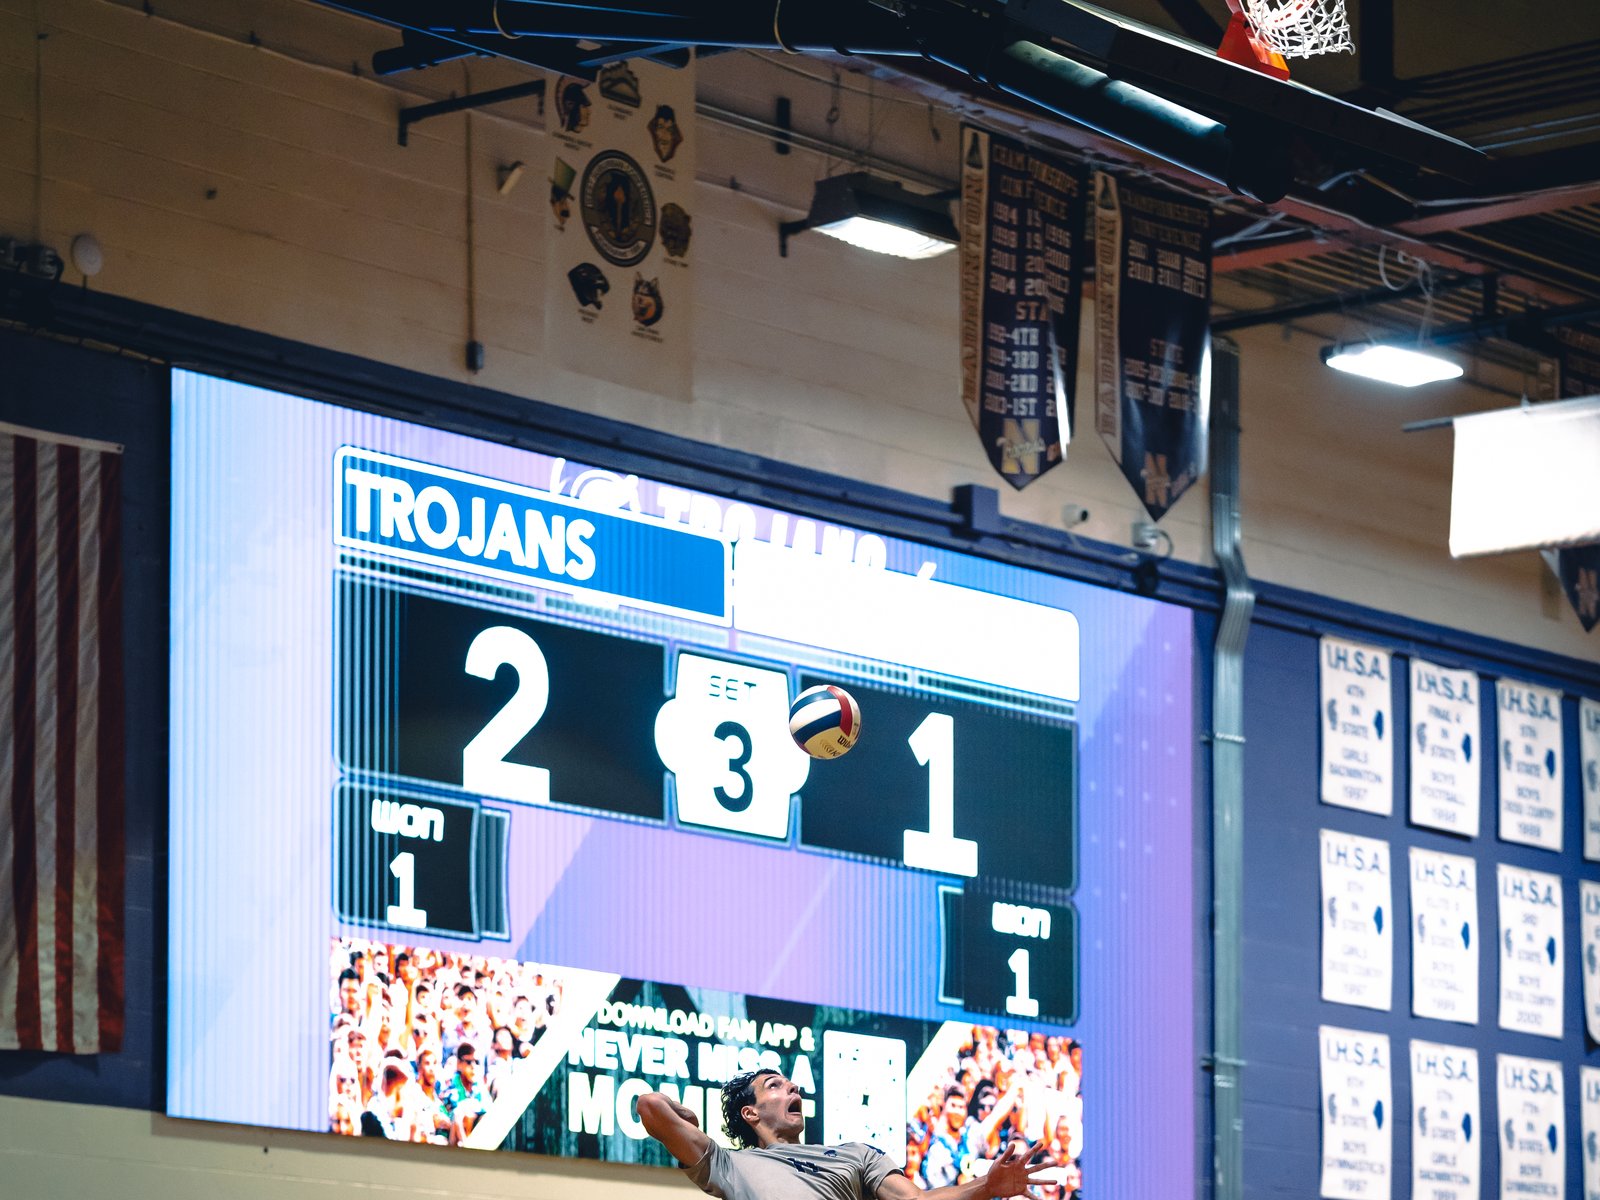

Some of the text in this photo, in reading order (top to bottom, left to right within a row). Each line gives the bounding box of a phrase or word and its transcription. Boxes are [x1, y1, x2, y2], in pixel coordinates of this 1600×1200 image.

[345, 468, 597, 581] TROJANS
[709, 675, 757, 702] SET
[1326, 645, 1386, 680] I.H.S.A.
[1417, 668, 1474, 704] I.H.S.A.
[463, 625, 550, 803] 2
[1500, 687, 1558, 722] I.H.S.A.
[713, 720, 754, 813] 3
[904, 711, 978, 877] 1
[387, 851, 427, 929] 1
[1503, 877, 1558, 908] I.H.S.A.
[1006, 948, 1039, 1017] 1
[597, 1001, 715, 1038] DOWNLOAD
[760, 1021, 798, 1049] APP
[800, 1026, 815, 1051] &
[568, 1027, 690, 1079] NEVER
[790, 1054, 817, 1096] A
[1504, 1065, 1558, 1096] I.H.S.A.
